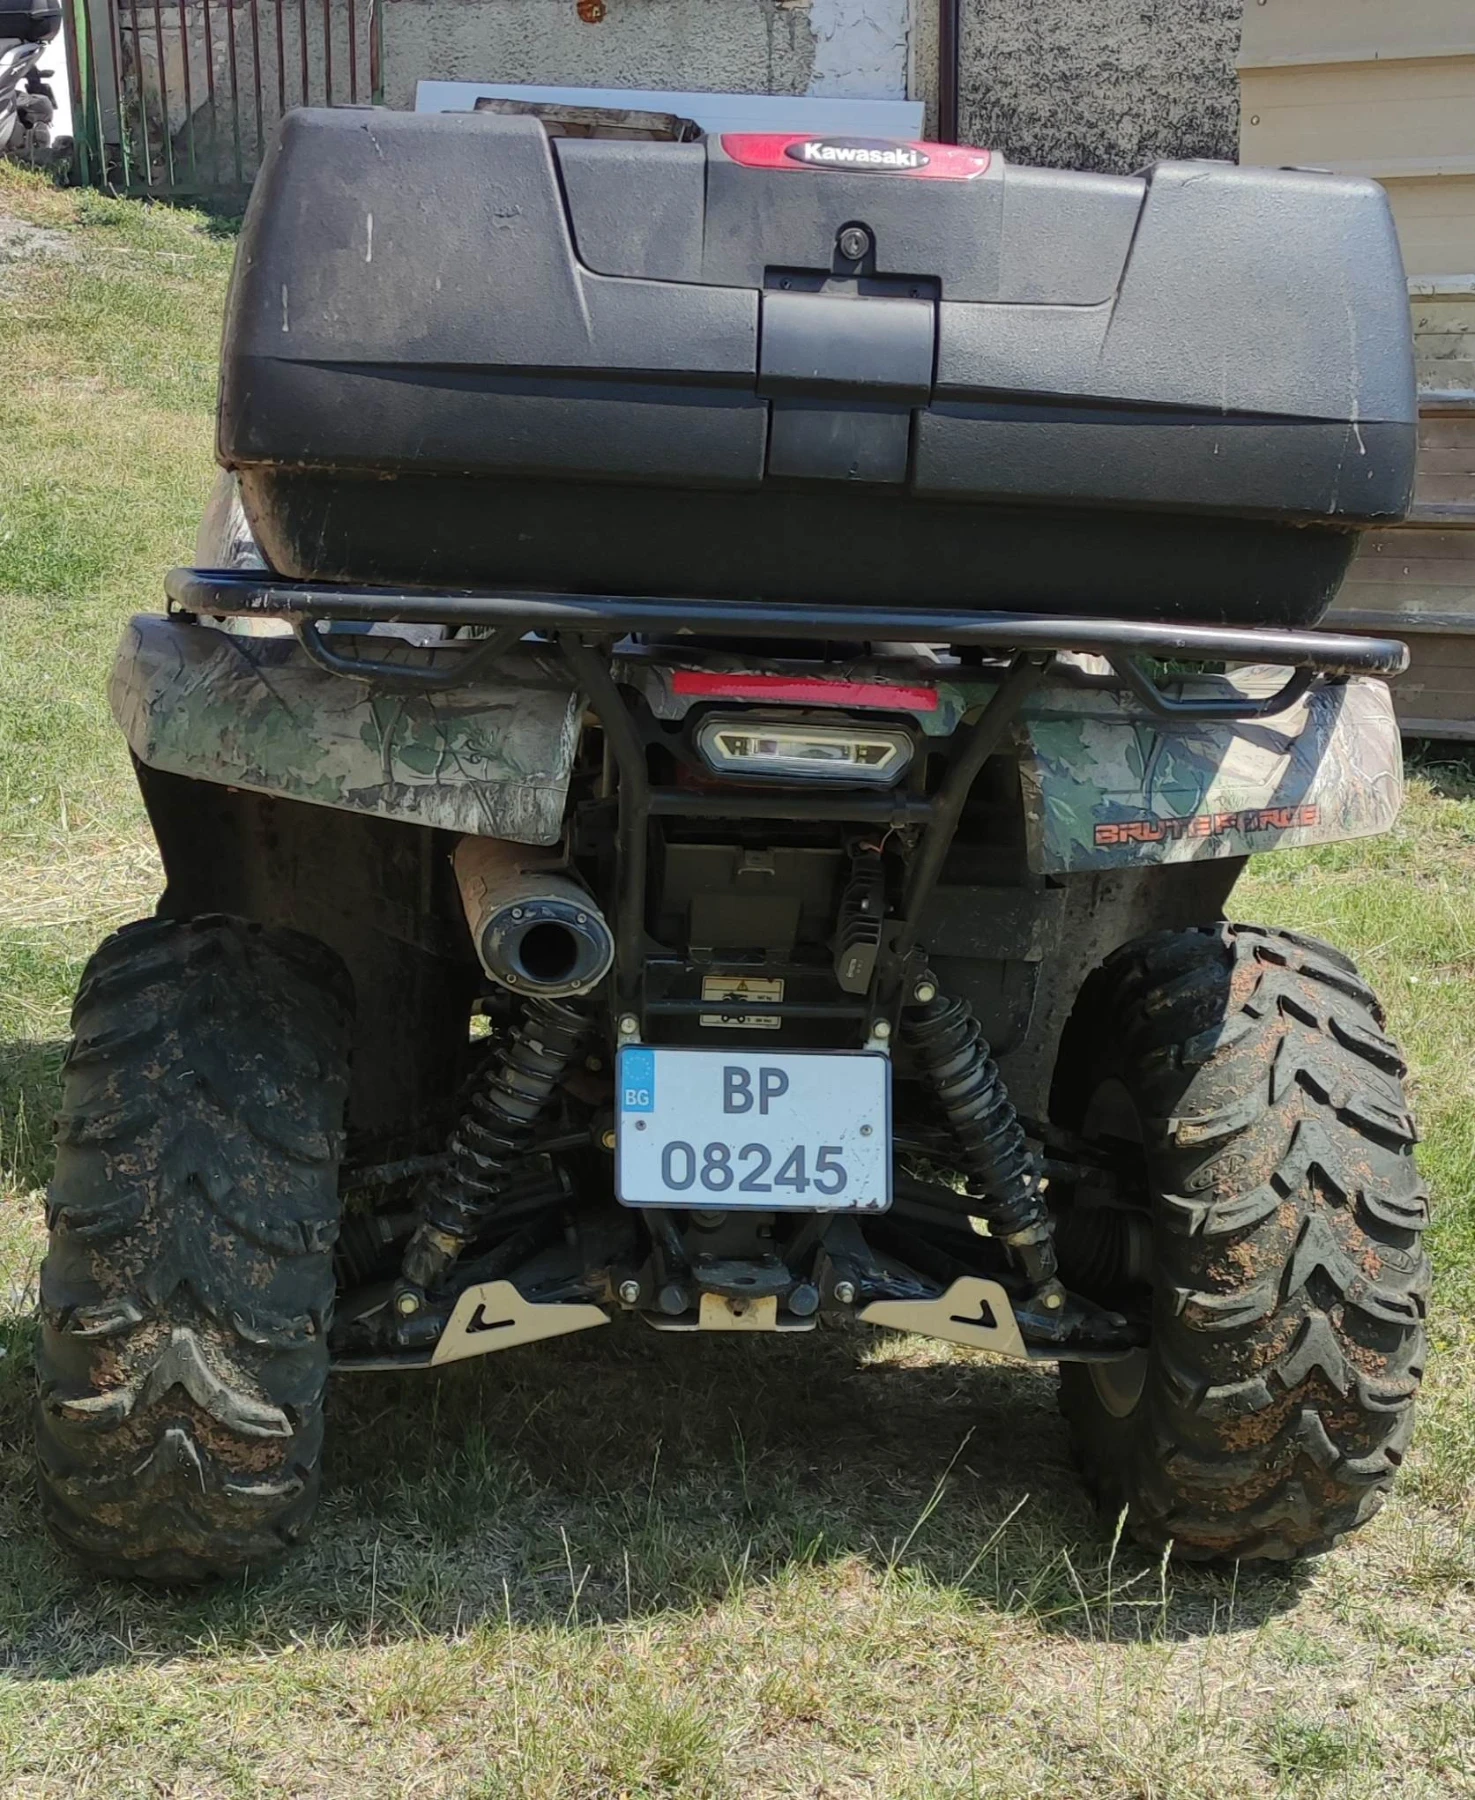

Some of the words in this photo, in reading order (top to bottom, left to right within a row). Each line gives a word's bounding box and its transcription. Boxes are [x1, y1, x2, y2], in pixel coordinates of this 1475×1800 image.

[804, 142, 917, 167] Kawasaki
[625, 1089, 650, 1106] BG
[723, 1066, 789, 1115] BP
[661, 1140, 848, 1195] 08245
